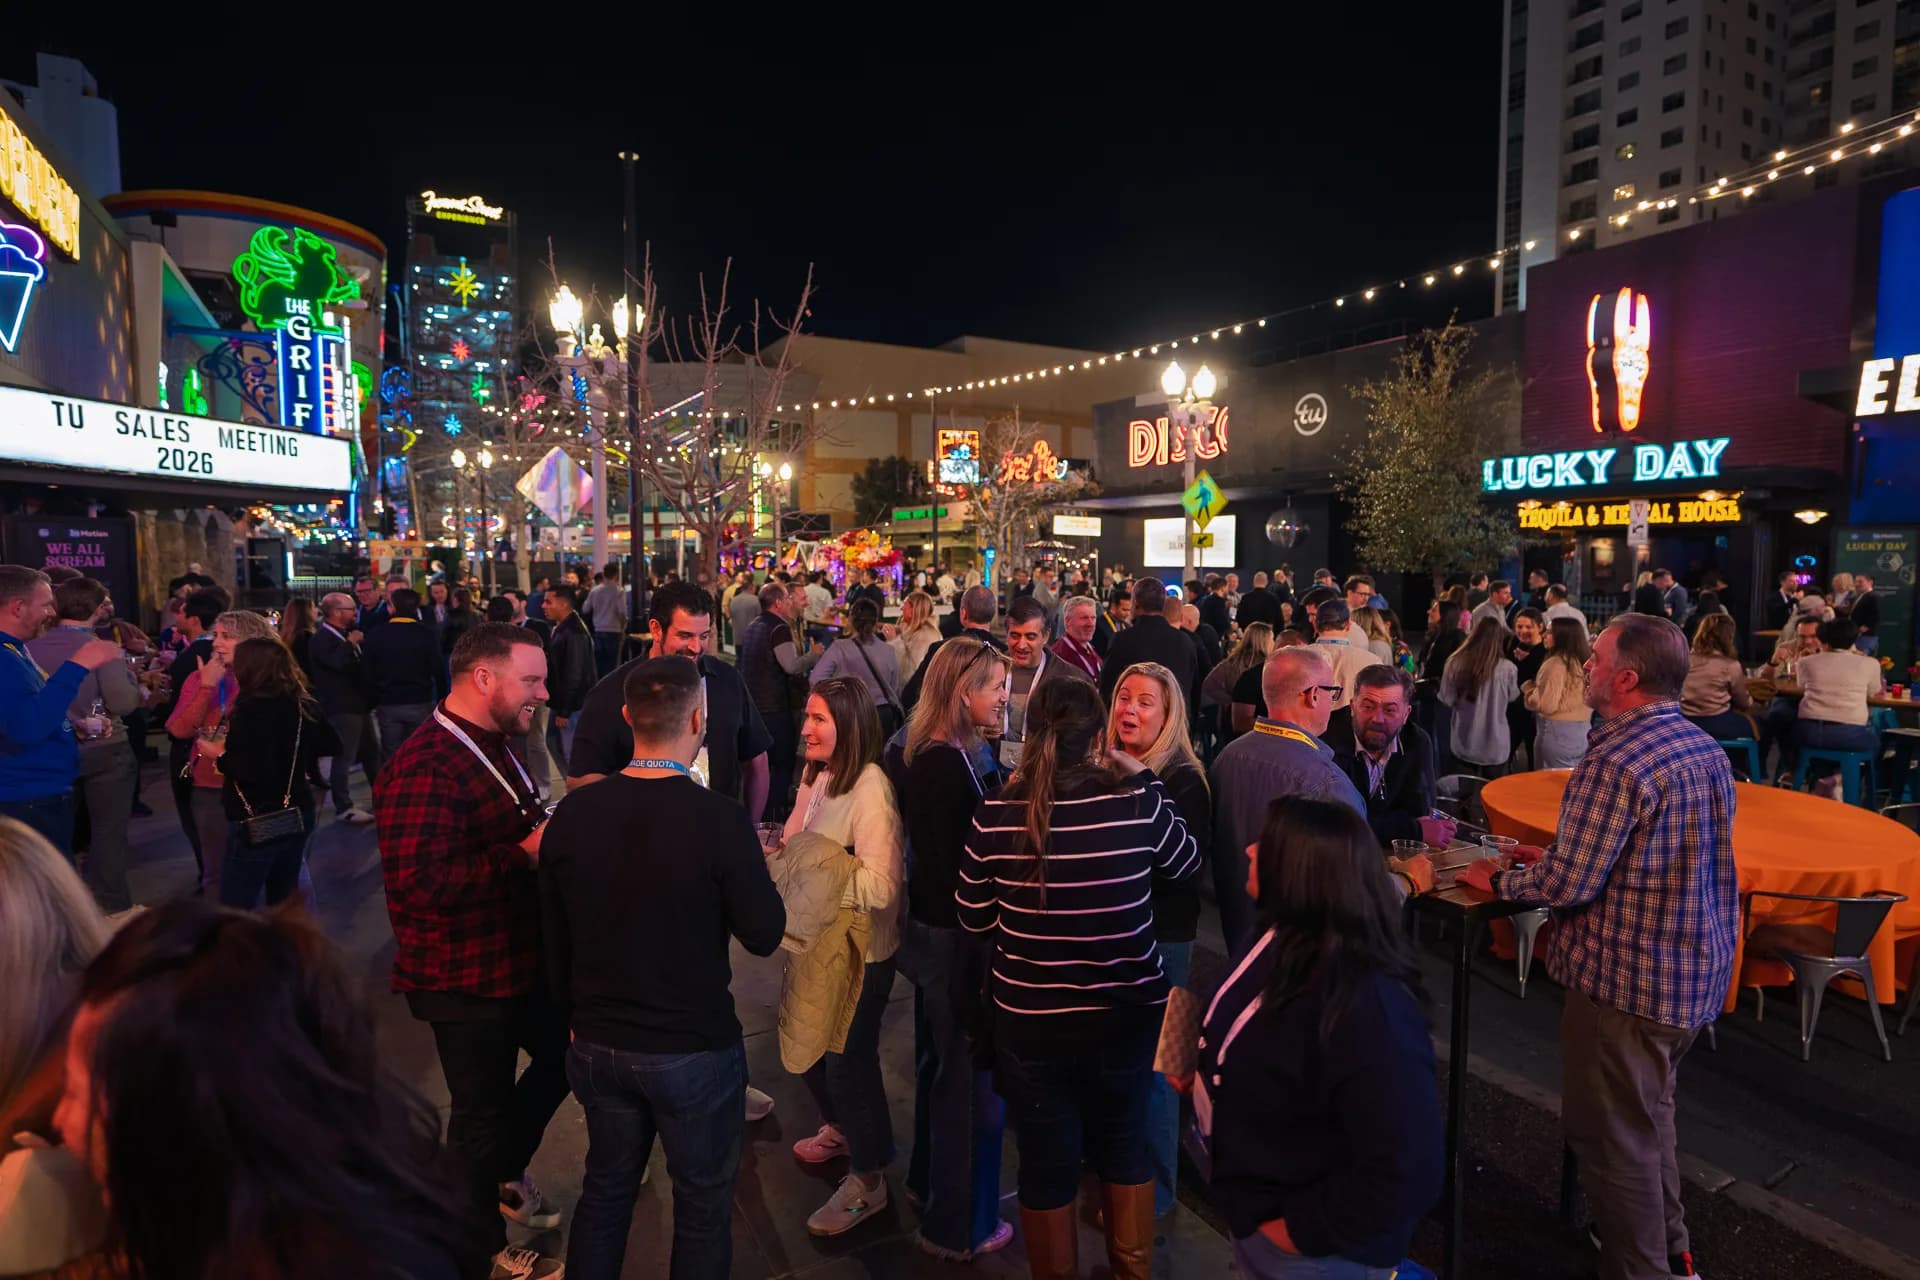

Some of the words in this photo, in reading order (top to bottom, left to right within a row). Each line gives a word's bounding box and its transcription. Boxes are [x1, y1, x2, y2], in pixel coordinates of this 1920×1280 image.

[284, 297, 312, 314] THE
[52, 401, 84, 429] TU
[115, 410, 191, 443] SALES
[218, 426, 299, 457] MEETING
[157, 447, 213, 474] 2026
[1483, 448, 1616, 492] LUCKY
[1633, 437, 1731, 482] DAY
[1518, 504, 1584, 531] TEQUILA
[1586, 505, 1599, 526] &
[1602, 502, 1674, 525] MEAL
[1678, 500, 1741, 523] HOUSE
[46, 543, 72, 555] WE
[77, 543, 105, 555] ALL
[1845, 541, 1883, 552] LUCKY
[1885, 541, 1909, 551] DAY
[45, 556, 106, 568] SCREAM
[646, 760, 675, 769] QUOTA
